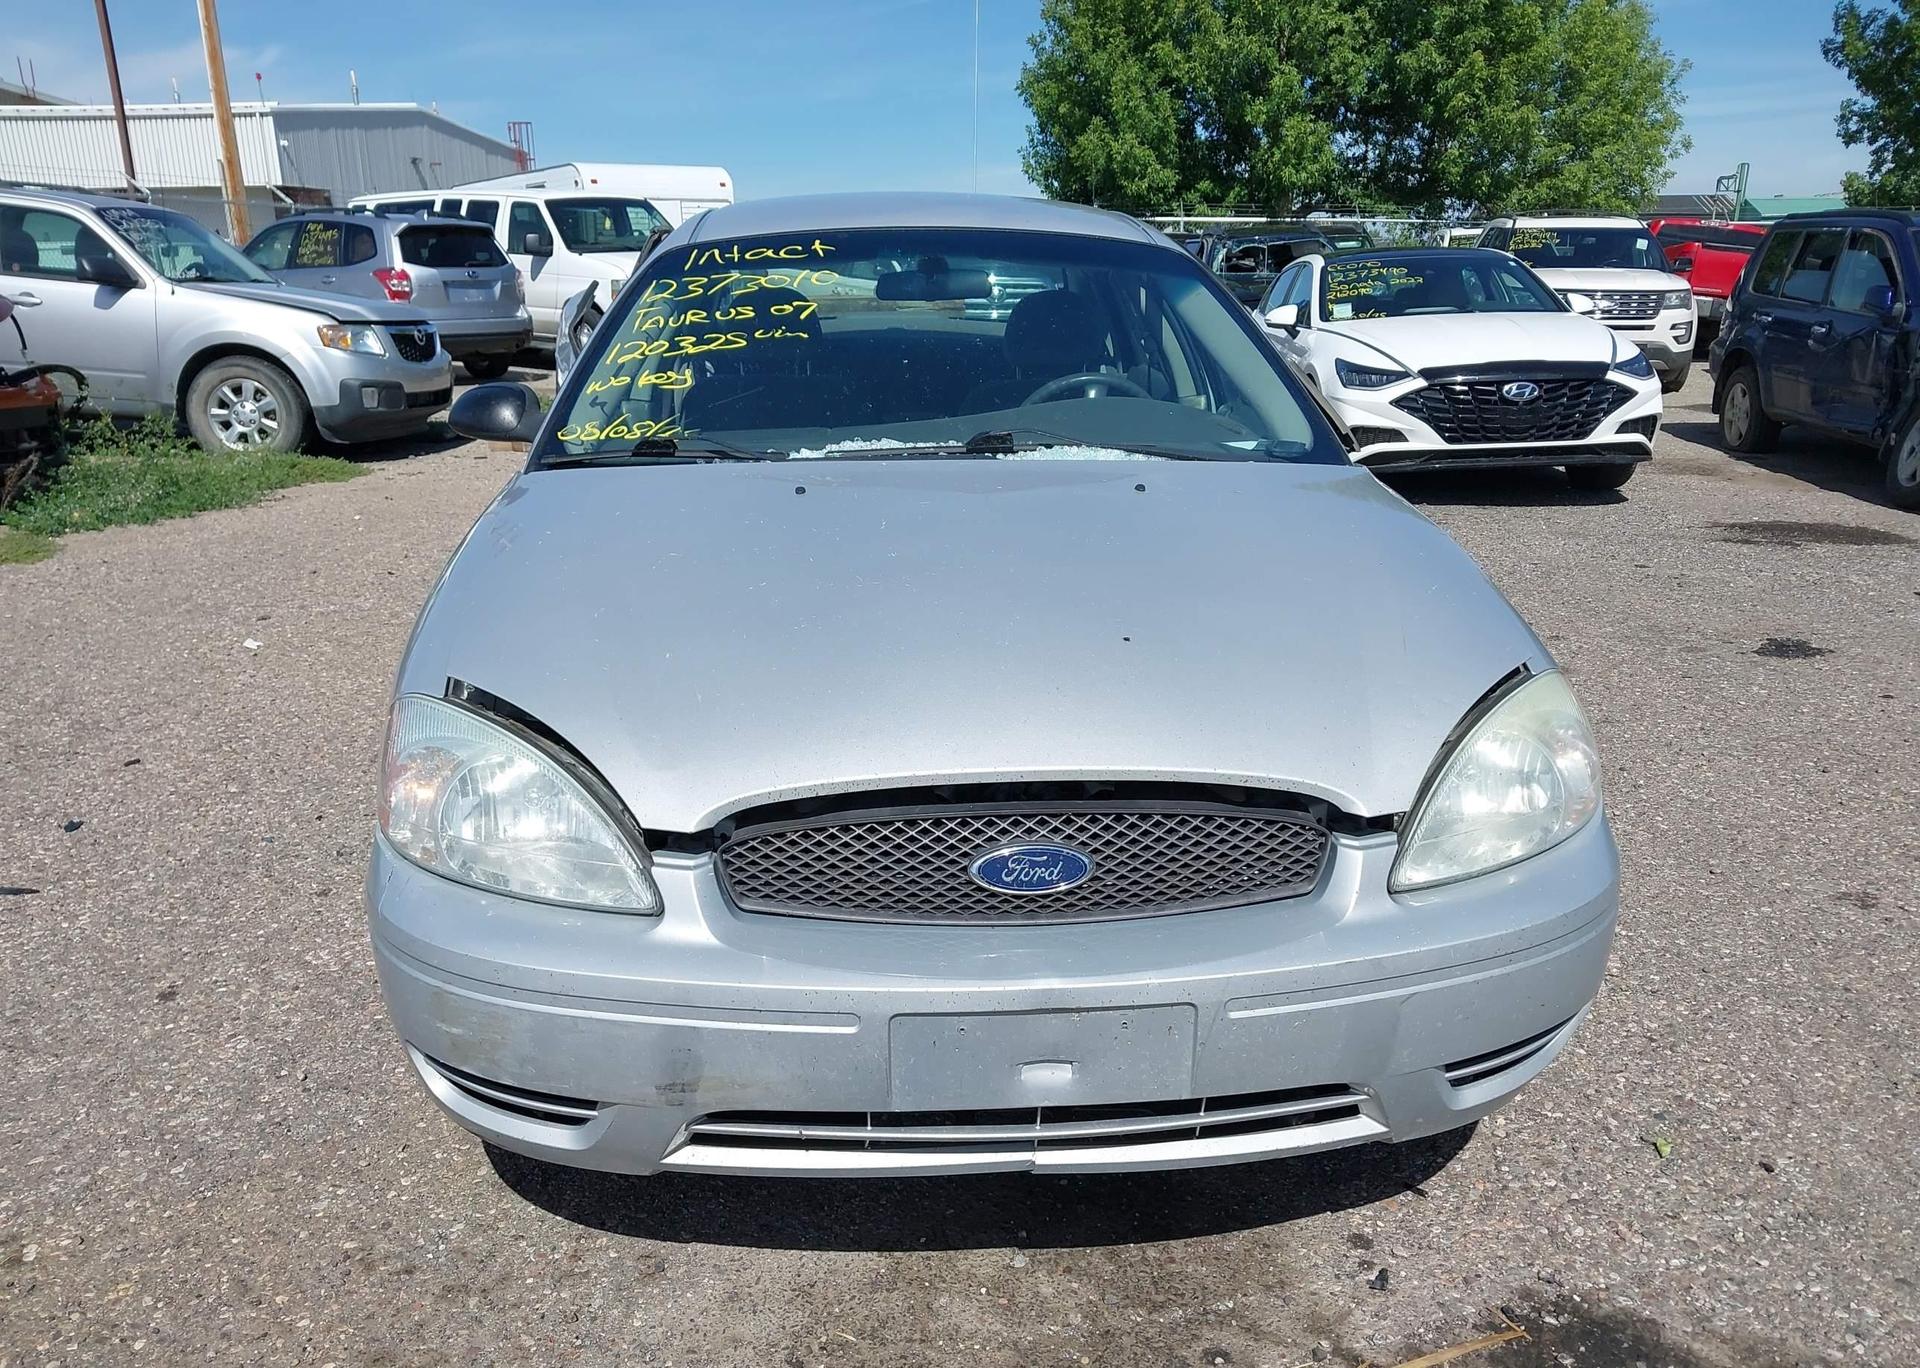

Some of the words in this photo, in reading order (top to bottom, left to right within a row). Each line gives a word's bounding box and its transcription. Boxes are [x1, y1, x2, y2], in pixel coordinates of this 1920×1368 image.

[639, 270, 839, 304] 12373010
[633, 306, 755, 331] TAURUS
[770, 301, 818, 321] 07
[605, 332, 748, 365] 120325
[1001, 854, 1063, 883] Ford
